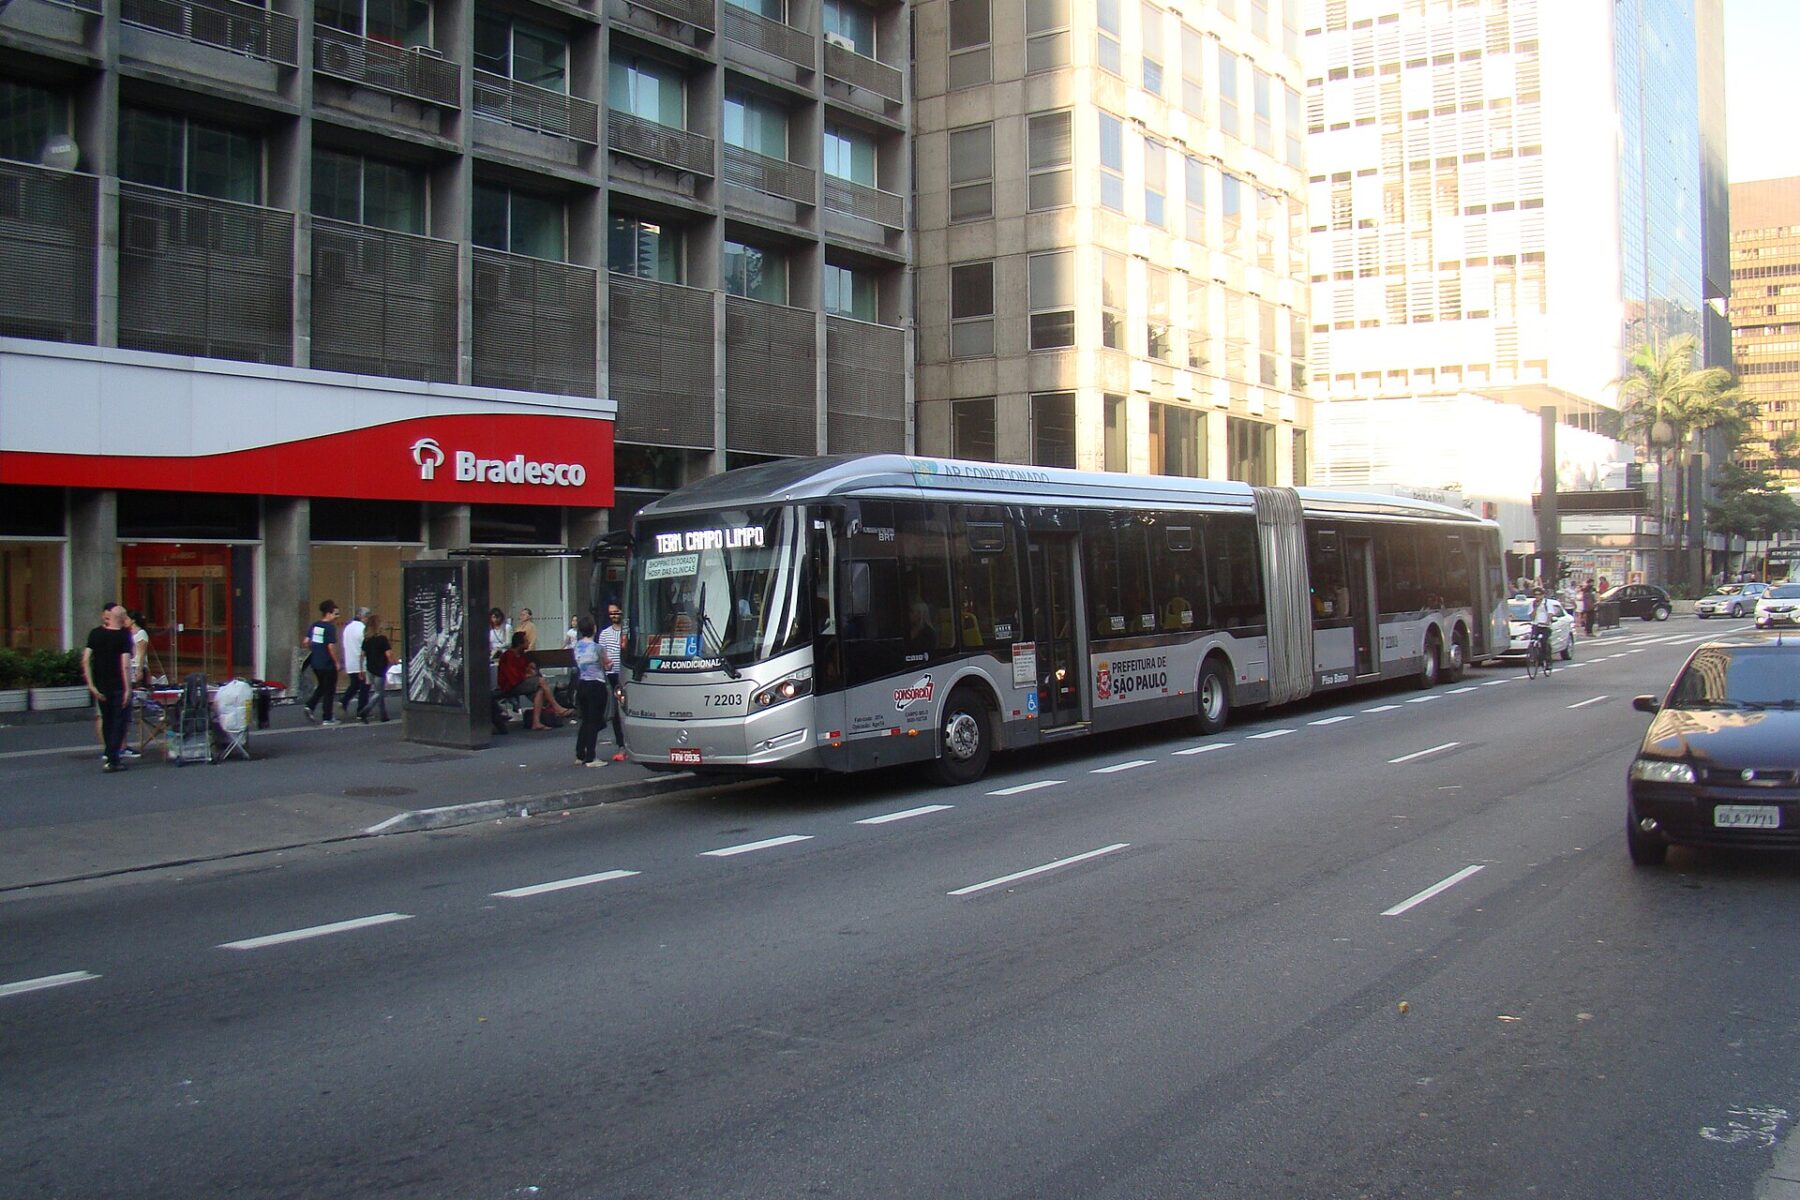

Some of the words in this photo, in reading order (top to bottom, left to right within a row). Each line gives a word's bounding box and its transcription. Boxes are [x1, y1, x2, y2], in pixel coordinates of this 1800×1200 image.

[456, 450, 586, 486] Bradesco
[944, 464, 961, 480] AR
[964, 466, 1051, 487] CONDICIONADO
[686, 529, 723, 551] CAMPO
[725, 527, 765, 548] LIMPO
[661, 660, 671, 669] AR
[1112, 658, 1156, 674] PREFEITURA
[1157, 656, 1167, 668] DE
[1113, 674, 1134, 694] SÃO
[1135, 672, 1167, 691] PAULO
[704, 695, 711, 706] 7
[714, 694, 742, 707] 2203
